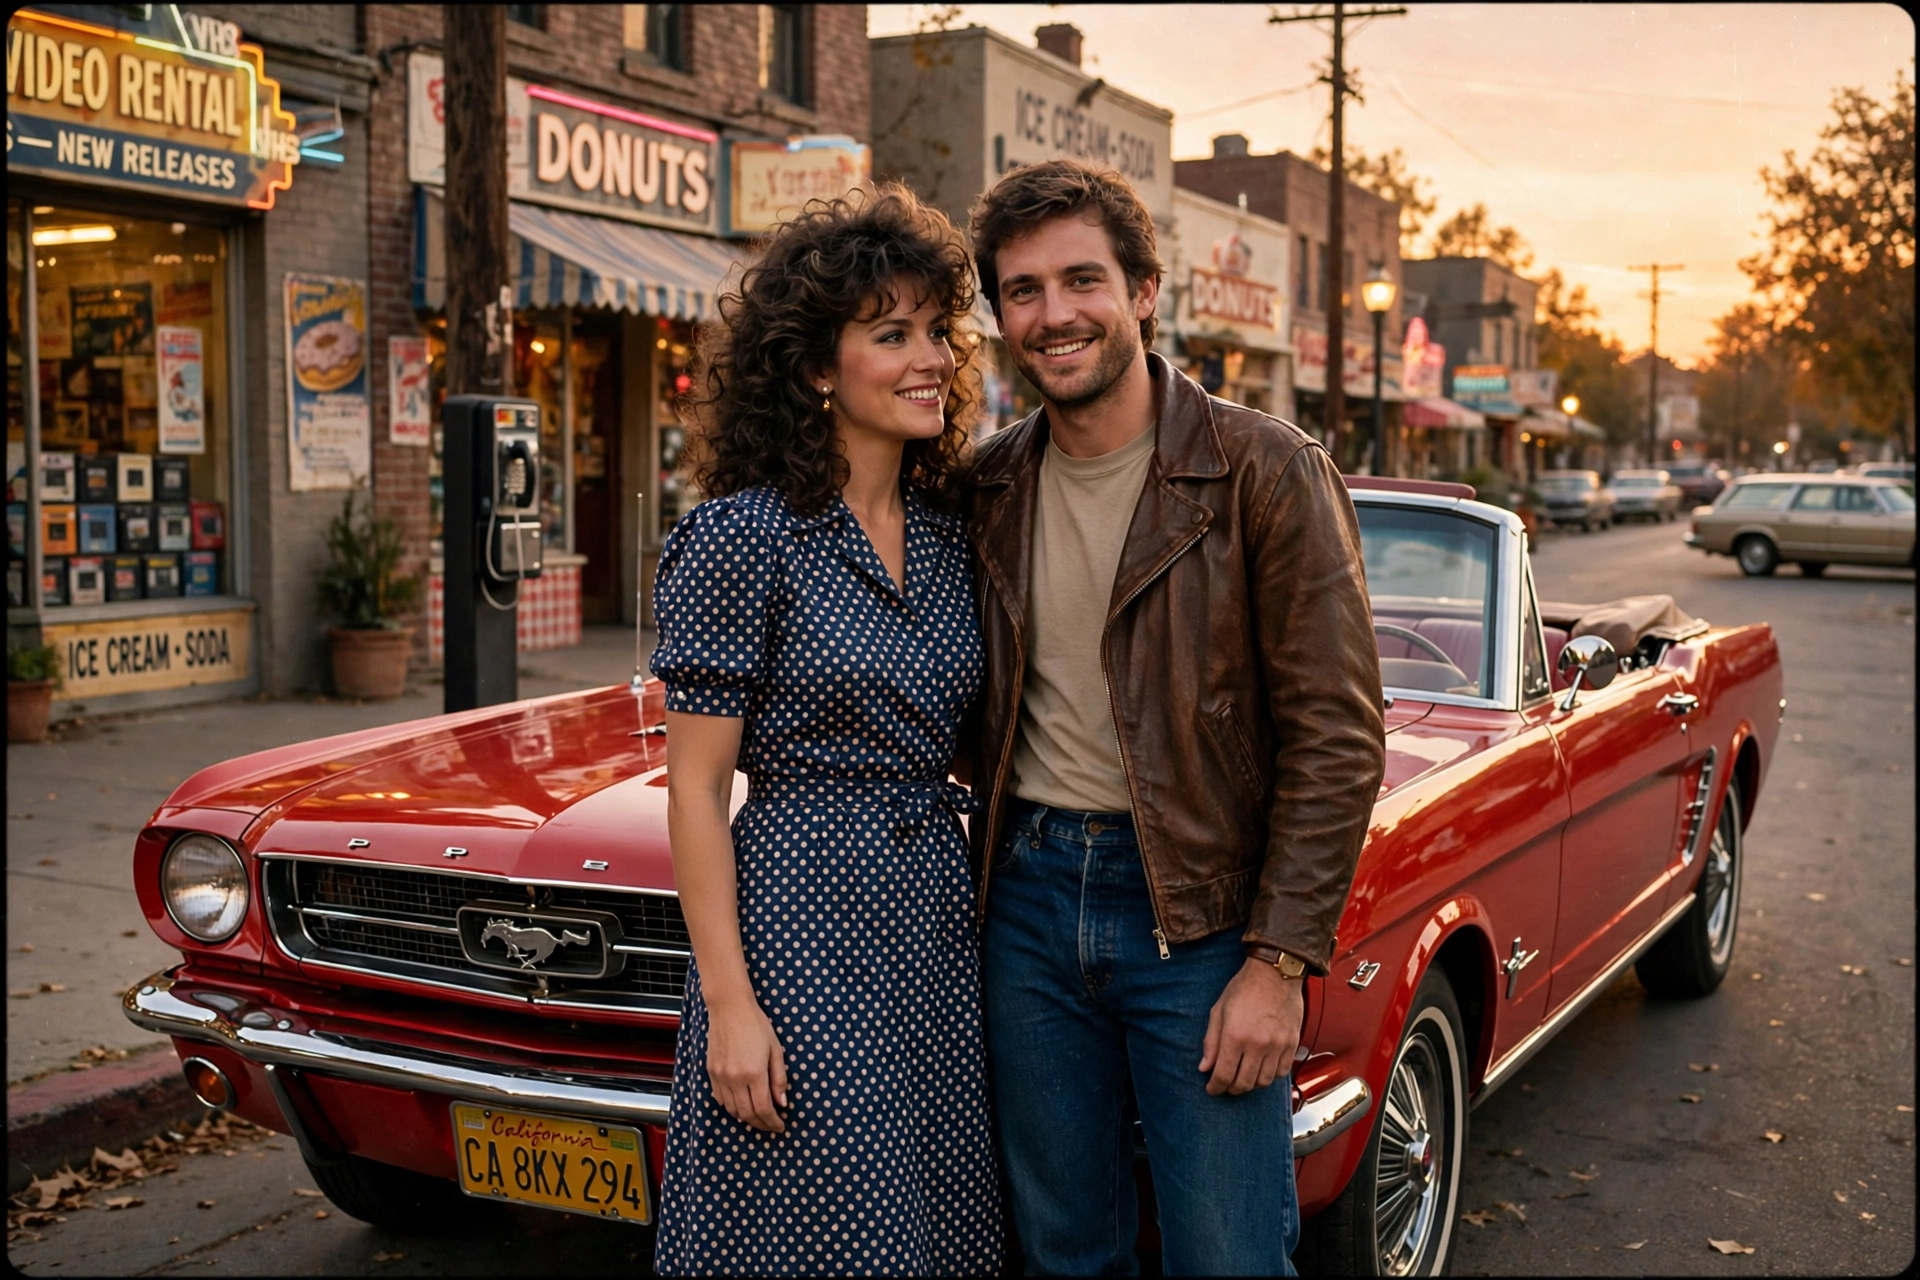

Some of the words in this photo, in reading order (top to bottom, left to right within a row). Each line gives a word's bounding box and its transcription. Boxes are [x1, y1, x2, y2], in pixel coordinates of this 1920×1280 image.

[7, 30, 109, 111] VIDEO
[120, 53, 242, 137] RENTAL
[1016, 87, 1046, 145] ICE
[58, 129, 114, 171] NEW
[122, 141, 236, 190] RELEASES
[537, 112, 710, 214] DONUTS
[69, 638, 99, 679] ICE
[106, 633, 170, 675] CREAM
[185, 628, 230, 668] SODA
[491, 1115, 608, 1151] California
[465, 1138, 504, 1187] CA
[513, 1146, 572, 1199] 8KX
[581, 1156, 640, 1210] 294
